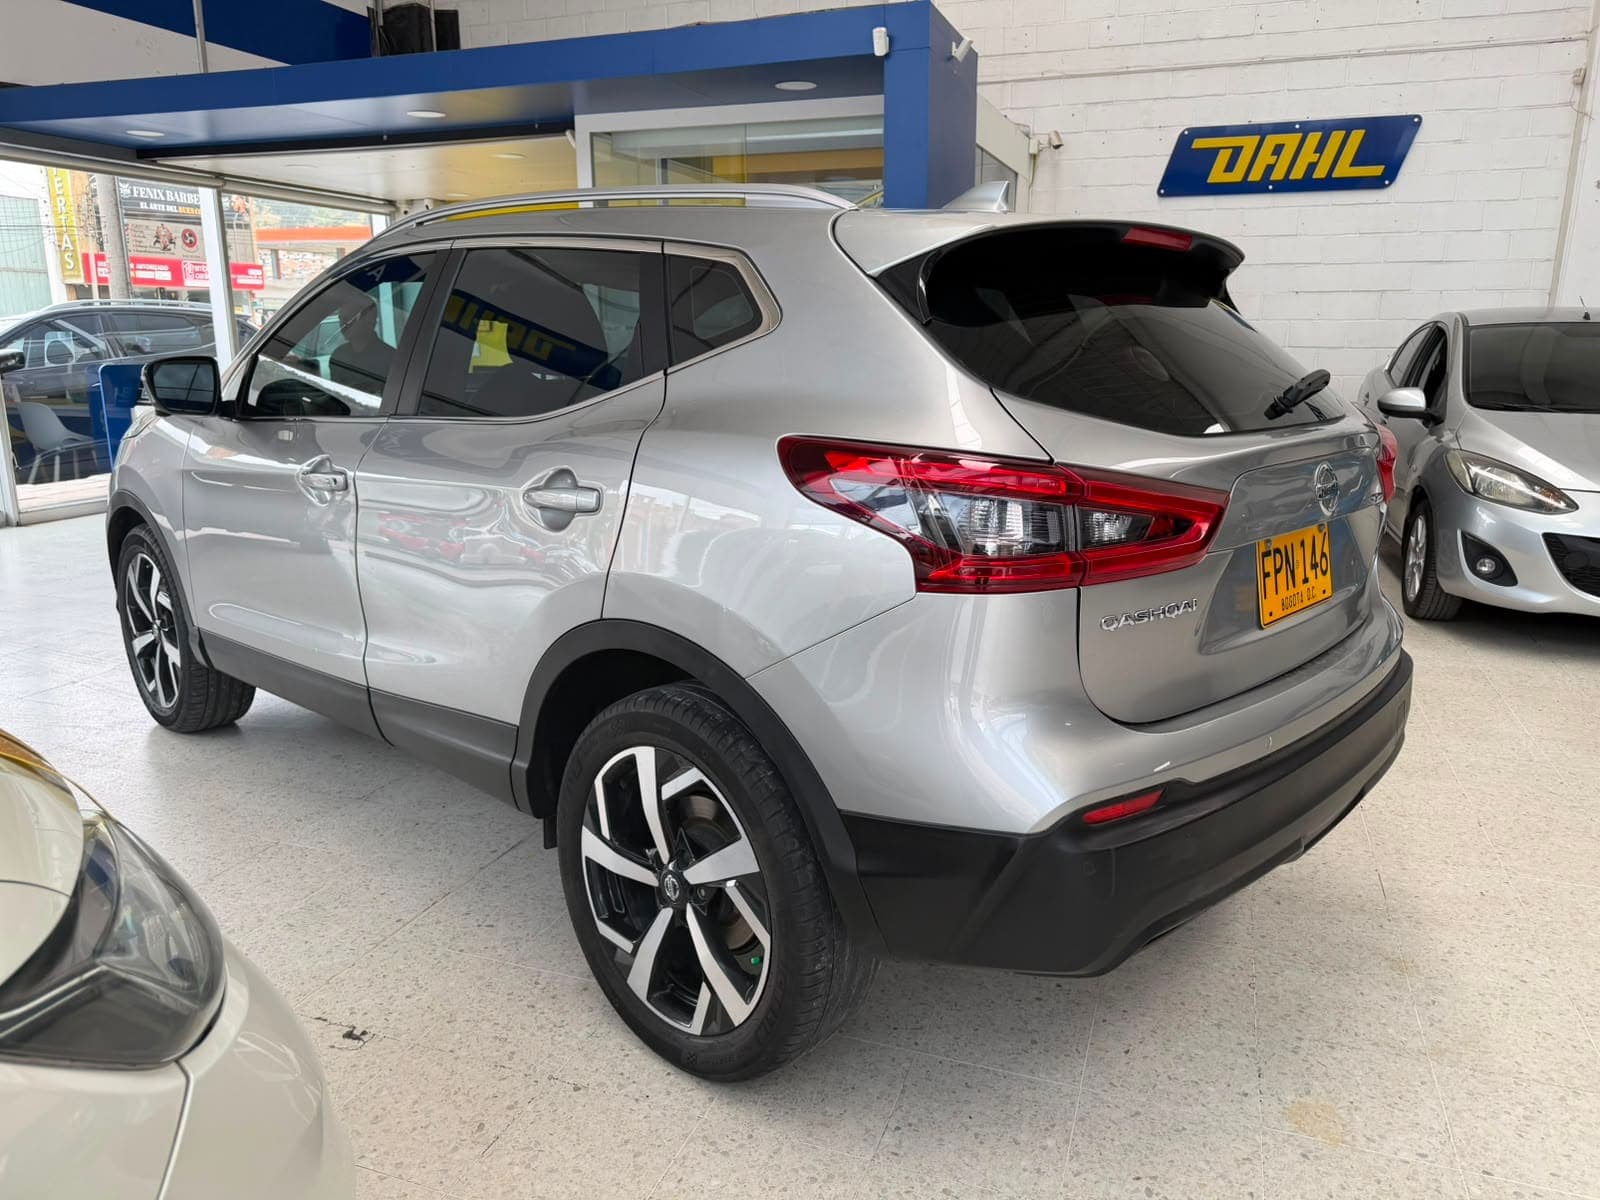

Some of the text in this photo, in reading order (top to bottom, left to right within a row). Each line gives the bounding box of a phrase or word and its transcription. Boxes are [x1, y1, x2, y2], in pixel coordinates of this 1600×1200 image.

[1192, 130, 1385, 183] DAHL
[133, 186, 165, 201] FENIX
[1261, 531, 1329, 600] FPN 146
[1100, 598, 1198, 632] QASHQAI
